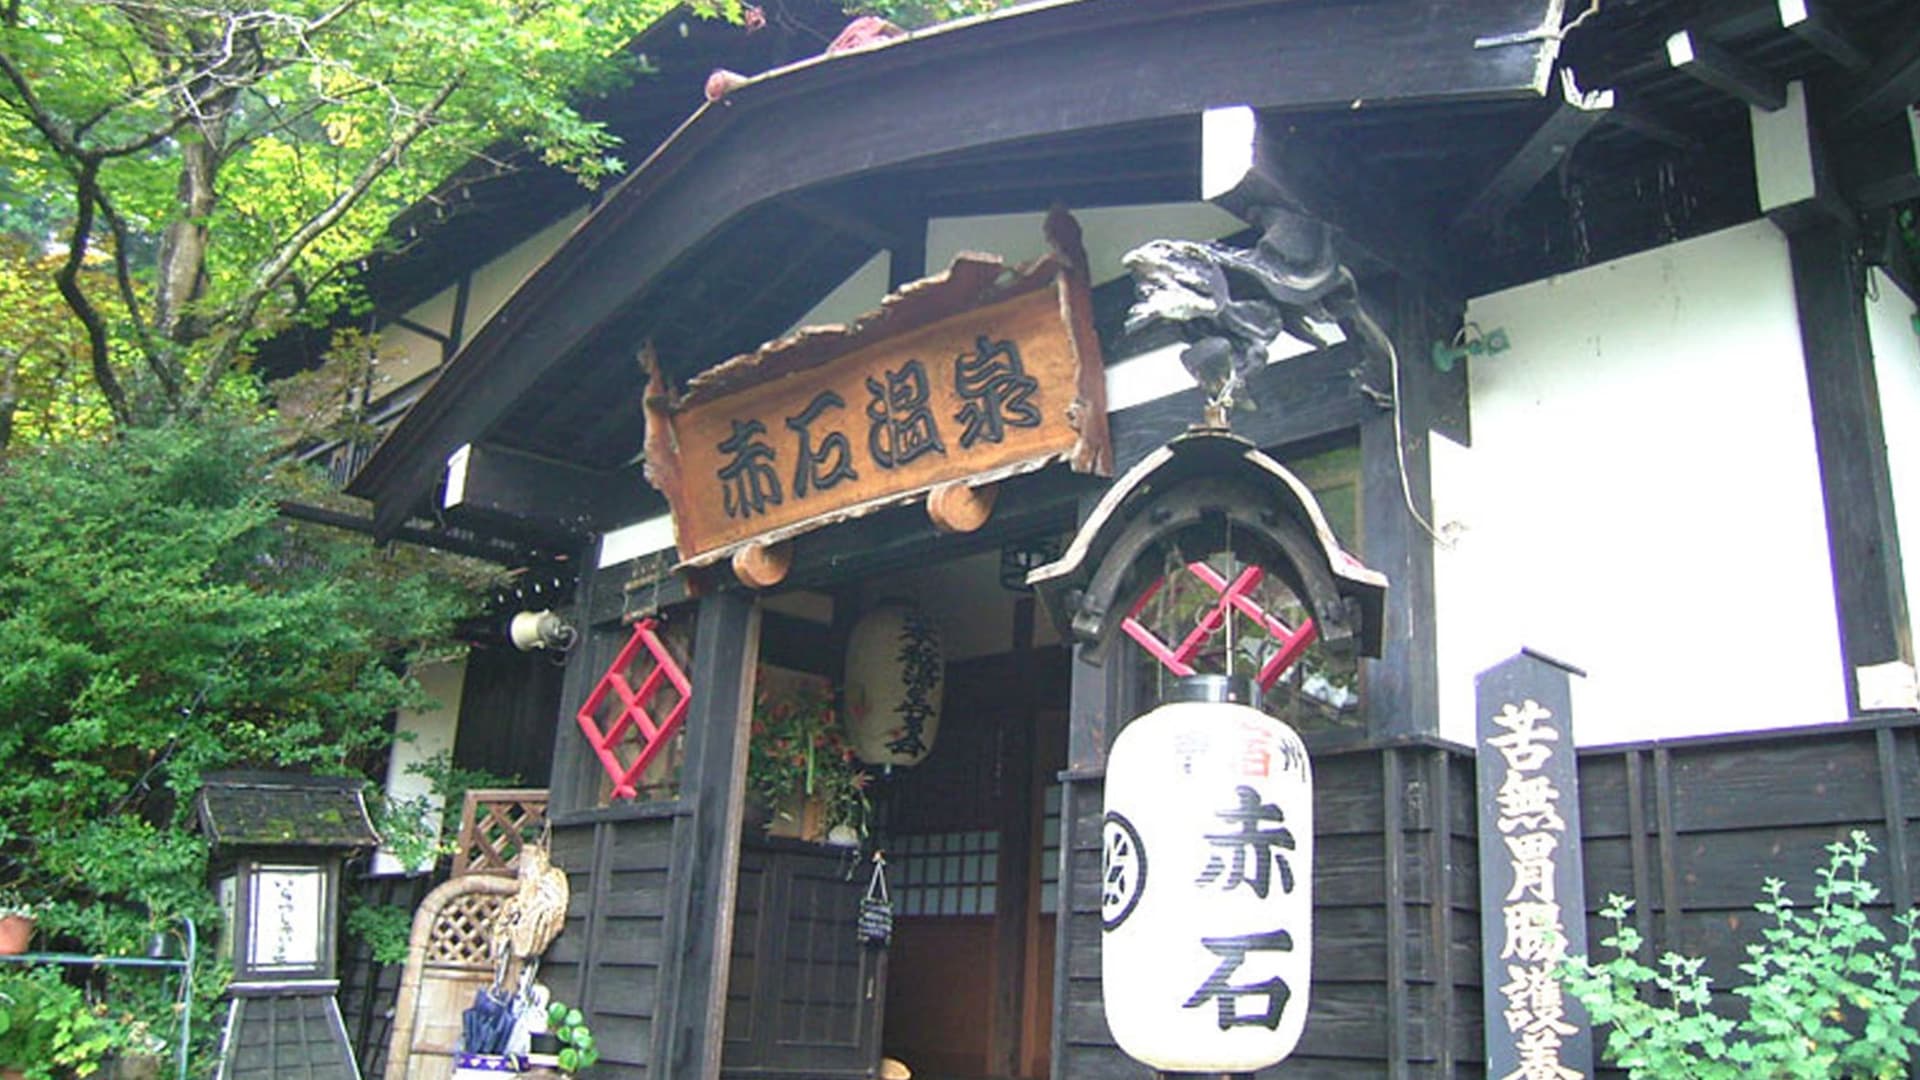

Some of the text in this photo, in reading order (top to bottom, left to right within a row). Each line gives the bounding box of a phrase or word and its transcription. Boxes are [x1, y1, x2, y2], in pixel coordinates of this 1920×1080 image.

[717, 333, 1042, 520] 赤石温泉
[1181, 784, 1297, 1032] 赤石
